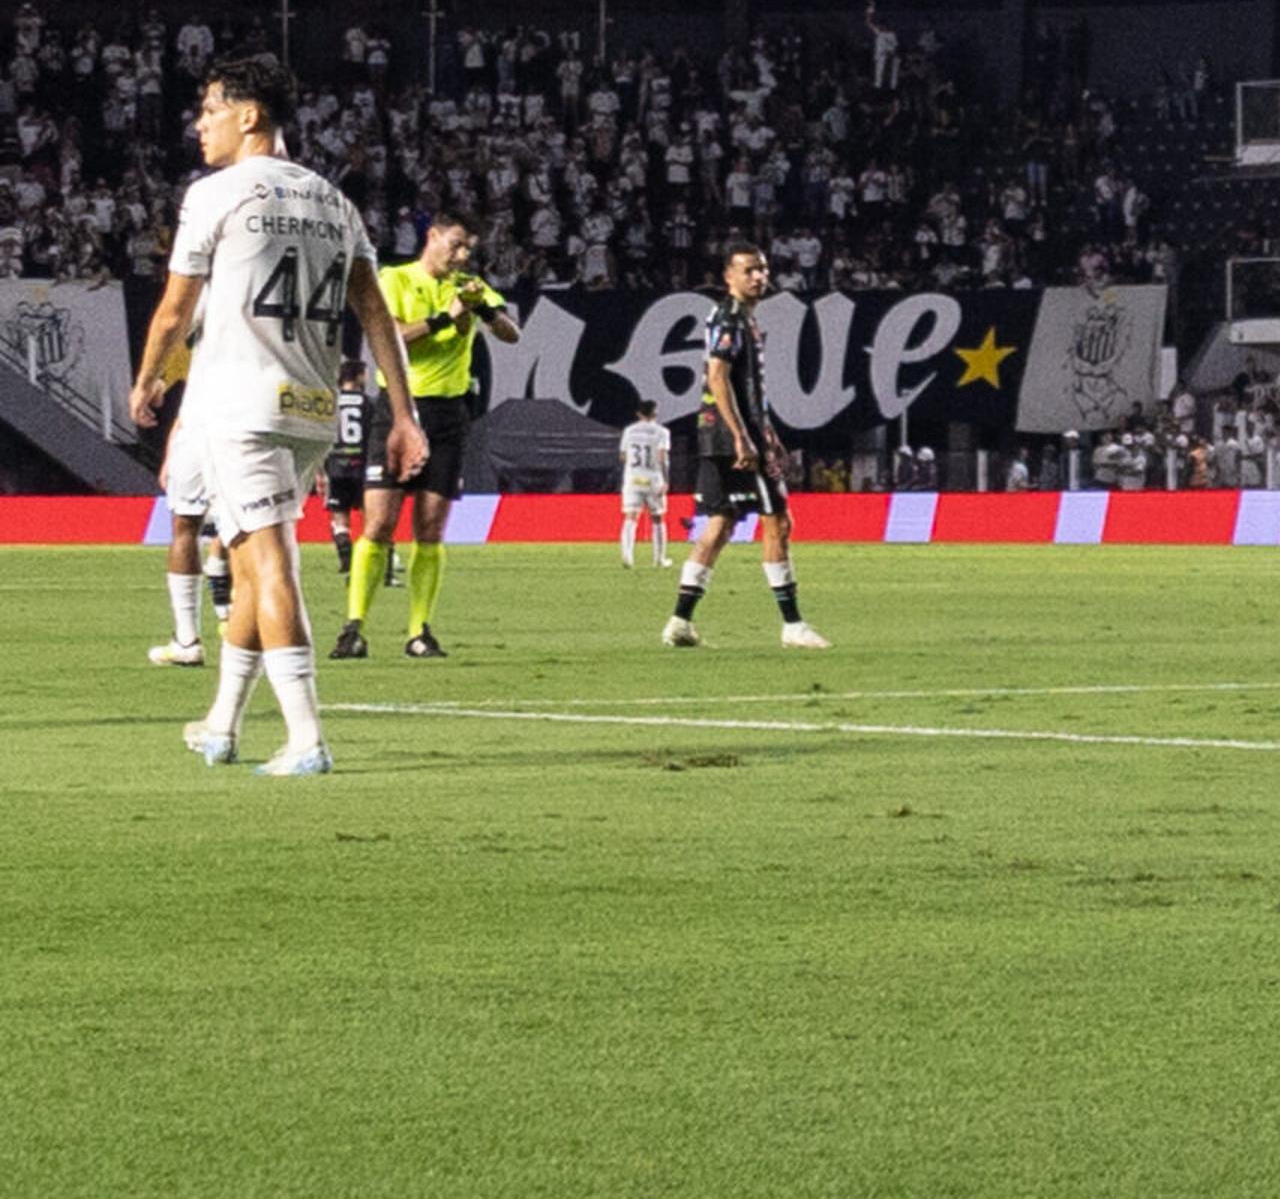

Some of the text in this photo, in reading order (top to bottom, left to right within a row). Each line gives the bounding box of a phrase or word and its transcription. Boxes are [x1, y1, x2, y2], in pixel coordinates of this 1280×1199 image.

[252, 246, 344, 347] 44
[340, 406, 362, 443] 6
[631, 443, 653, 470] 31
